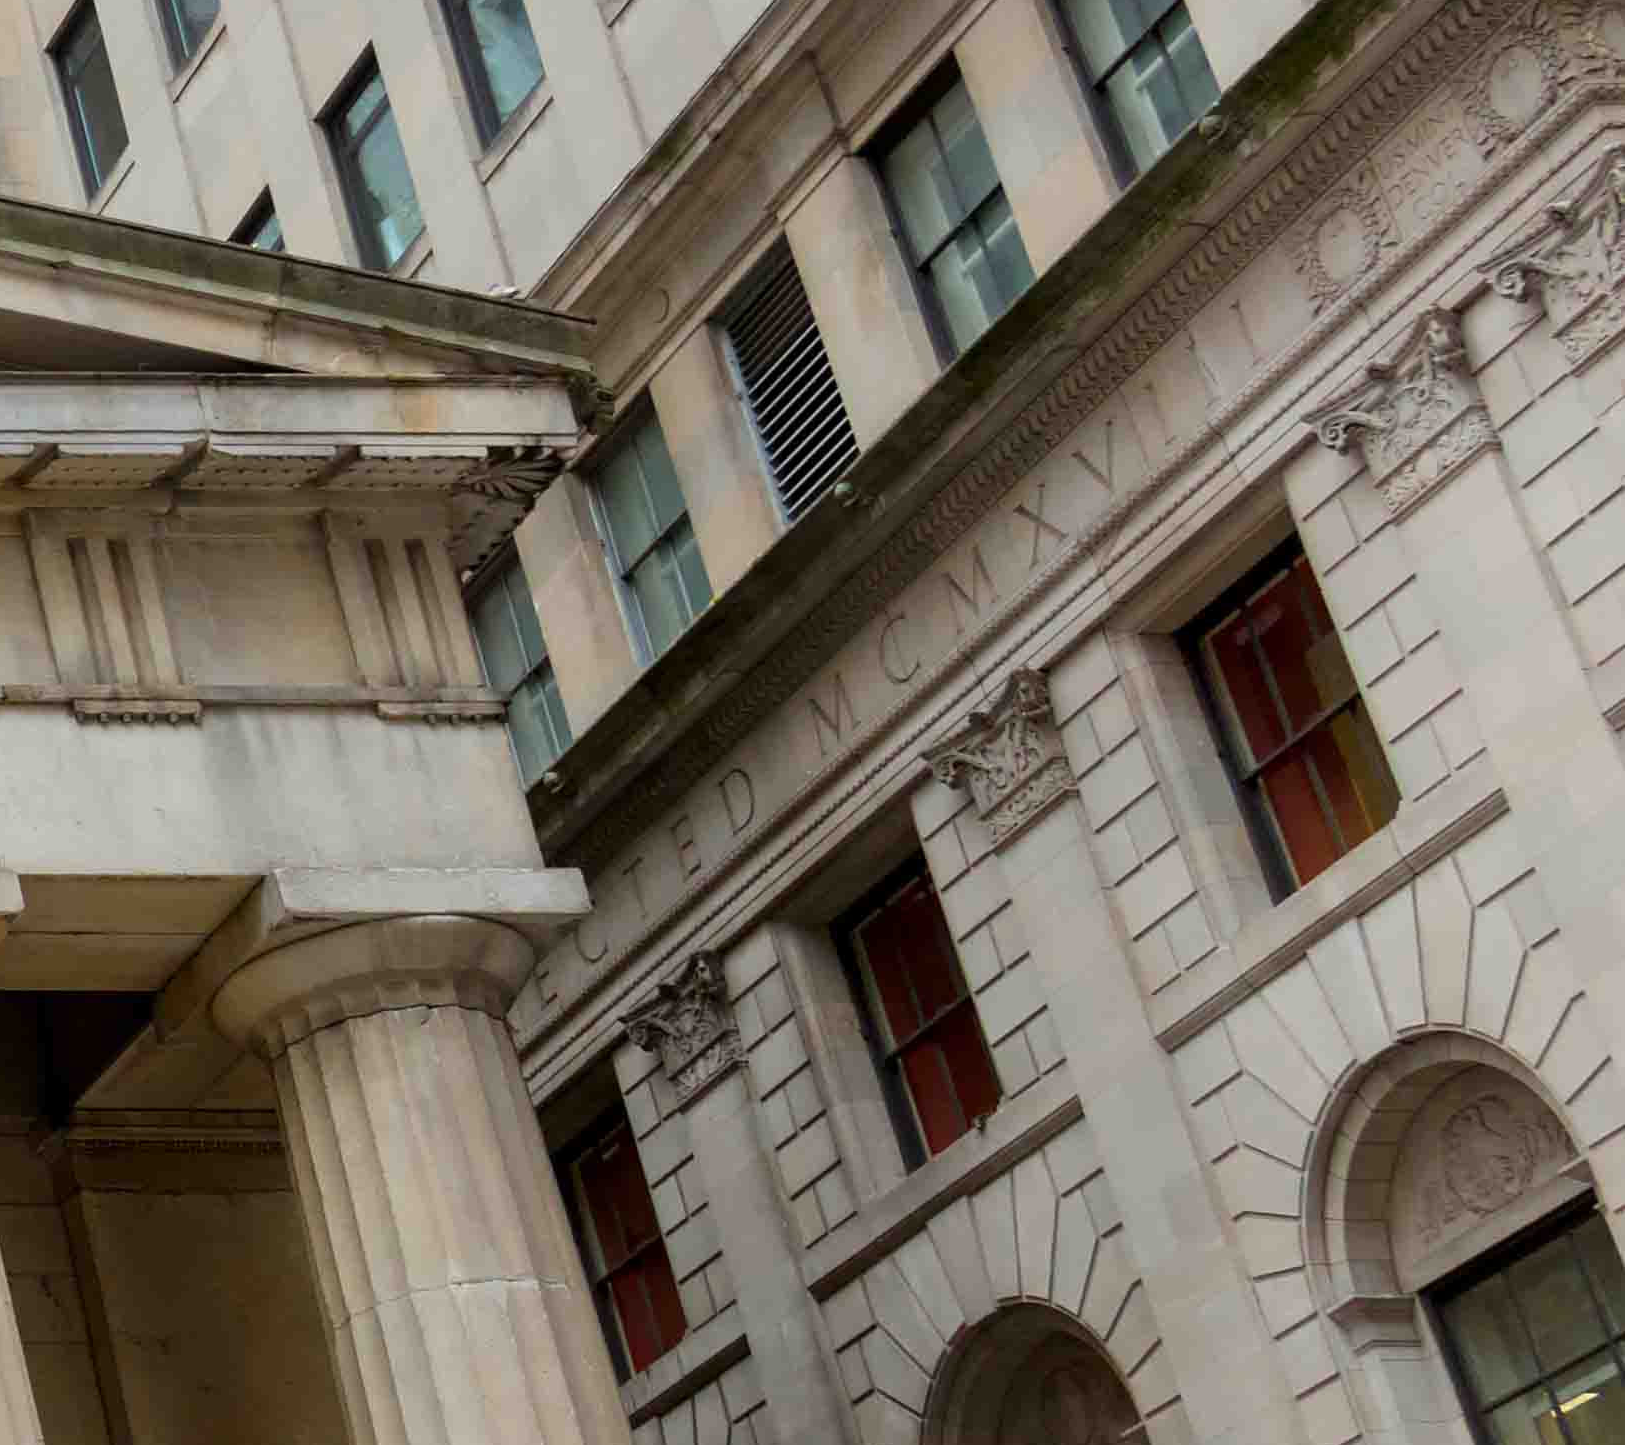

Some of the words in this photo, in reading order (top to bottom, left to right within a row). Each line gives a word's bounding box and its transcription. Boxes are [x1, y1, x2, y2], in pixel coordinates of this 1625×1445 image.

[1387, 126, 1468, 209] DENVER
[533, 767, 756, 1010] ECTED
[807, 300, 1264, 758] MCMXVIII
